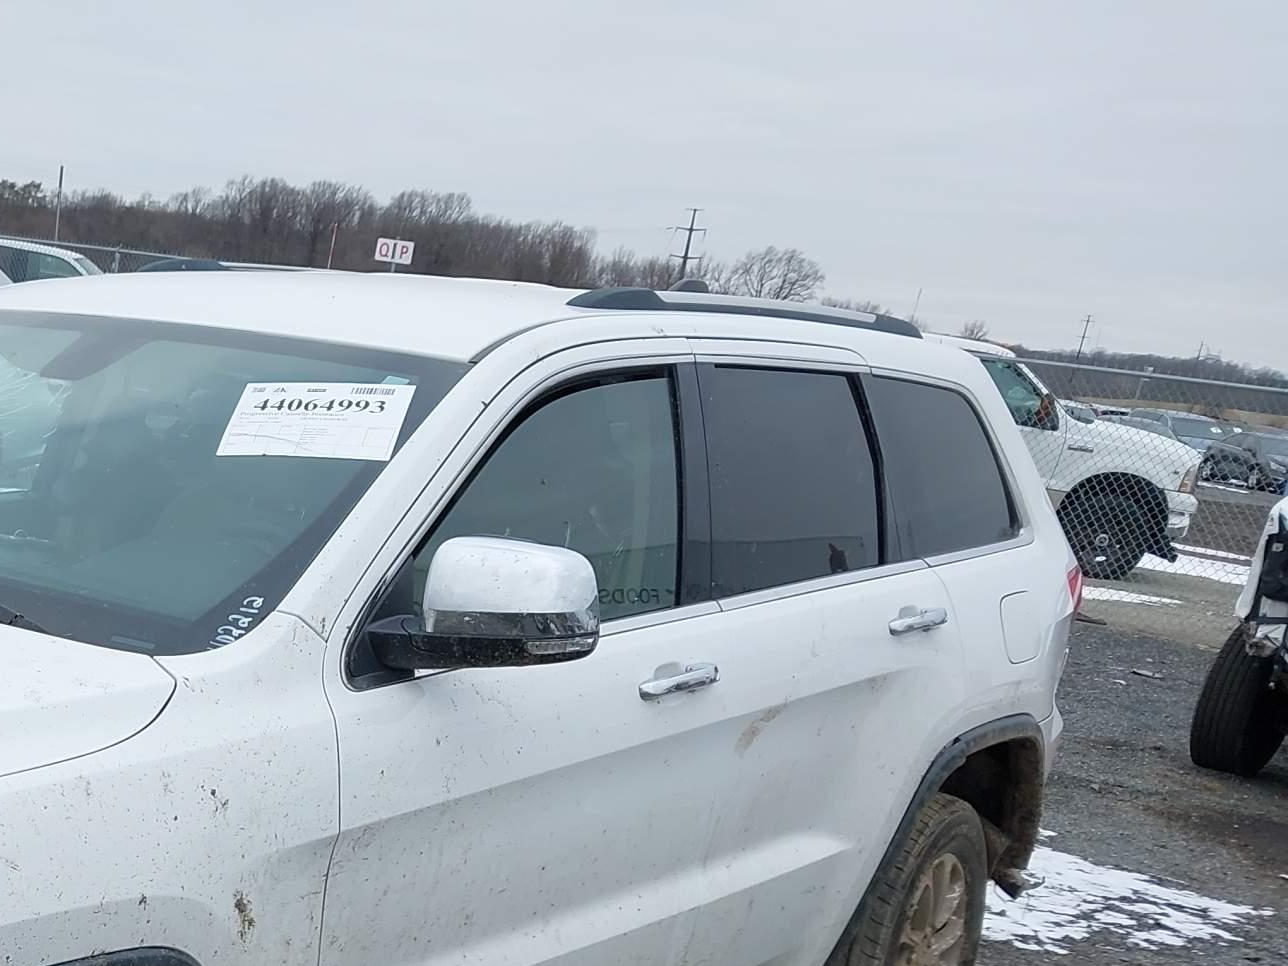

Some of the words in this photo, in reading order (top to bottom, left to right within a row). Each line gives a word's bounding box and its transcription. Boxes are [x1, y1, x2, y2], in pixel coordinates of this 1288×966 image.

[379, 243, 389, 257] Q
[400, 245, 409, 259] P
[253, 398, 387, 414] 44064993
